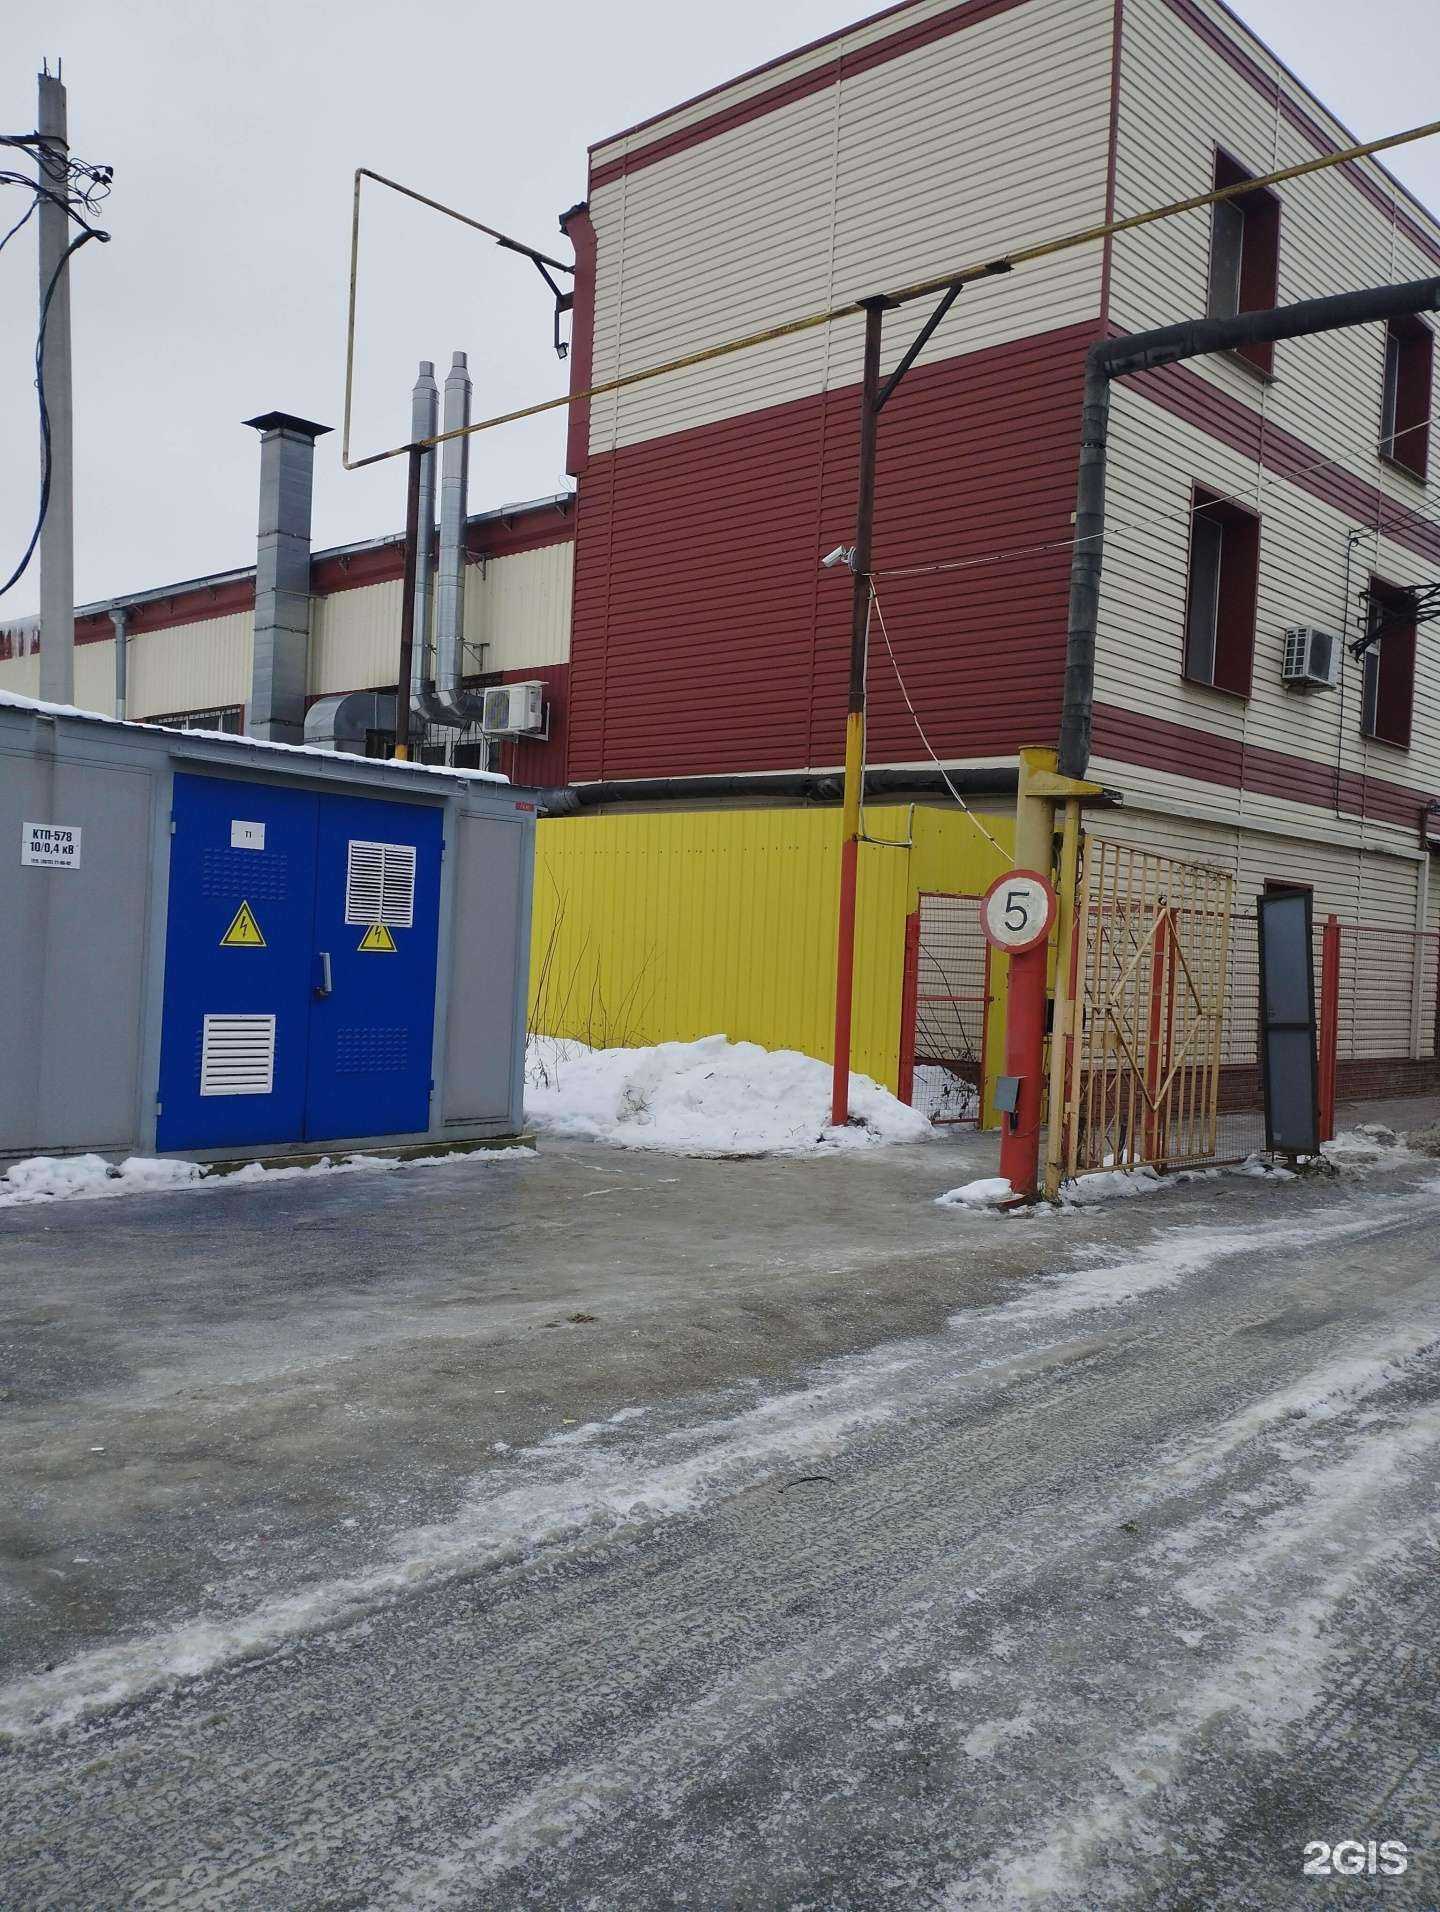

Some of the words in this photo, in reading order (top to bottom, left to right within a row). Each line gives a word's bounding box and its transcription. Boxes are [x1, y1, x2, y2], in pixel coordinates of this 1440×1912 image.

[32, 829, 72, 842] КТП-578
[30, 841, 60, 854] 10/0,4
[1005, 891, 1030, 932] 5
